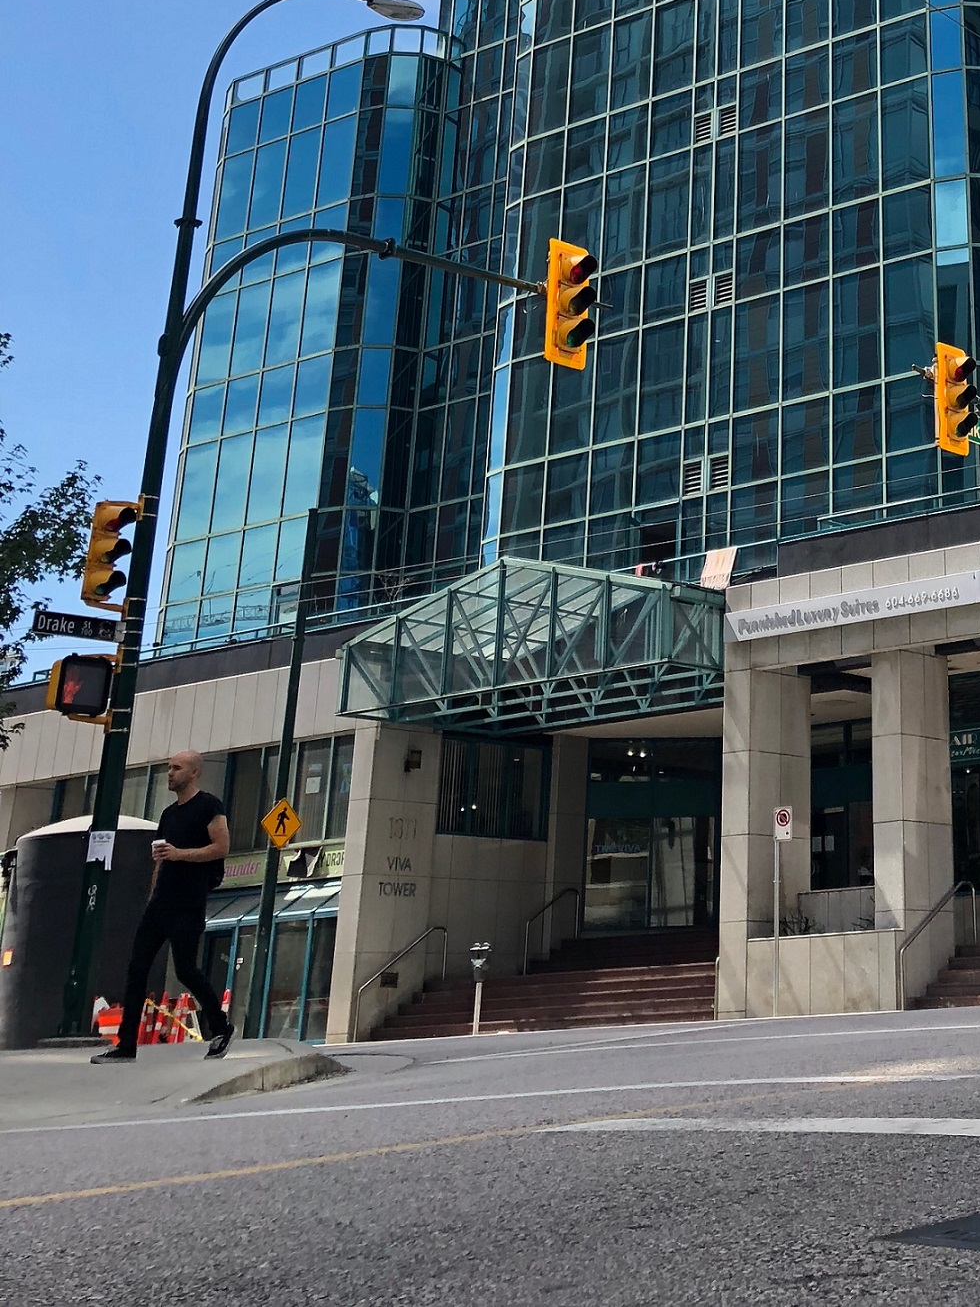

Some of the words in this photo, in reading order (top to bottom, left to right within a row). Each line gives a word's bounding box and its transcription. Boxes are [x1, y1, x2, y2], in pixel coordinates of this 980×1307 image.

[37, 615, 75, 633] Drake
[951, 734, 978, 746] AIR
[387, 856, 412, 871] VIVA
[379, 881, 416, 897] TOWER
